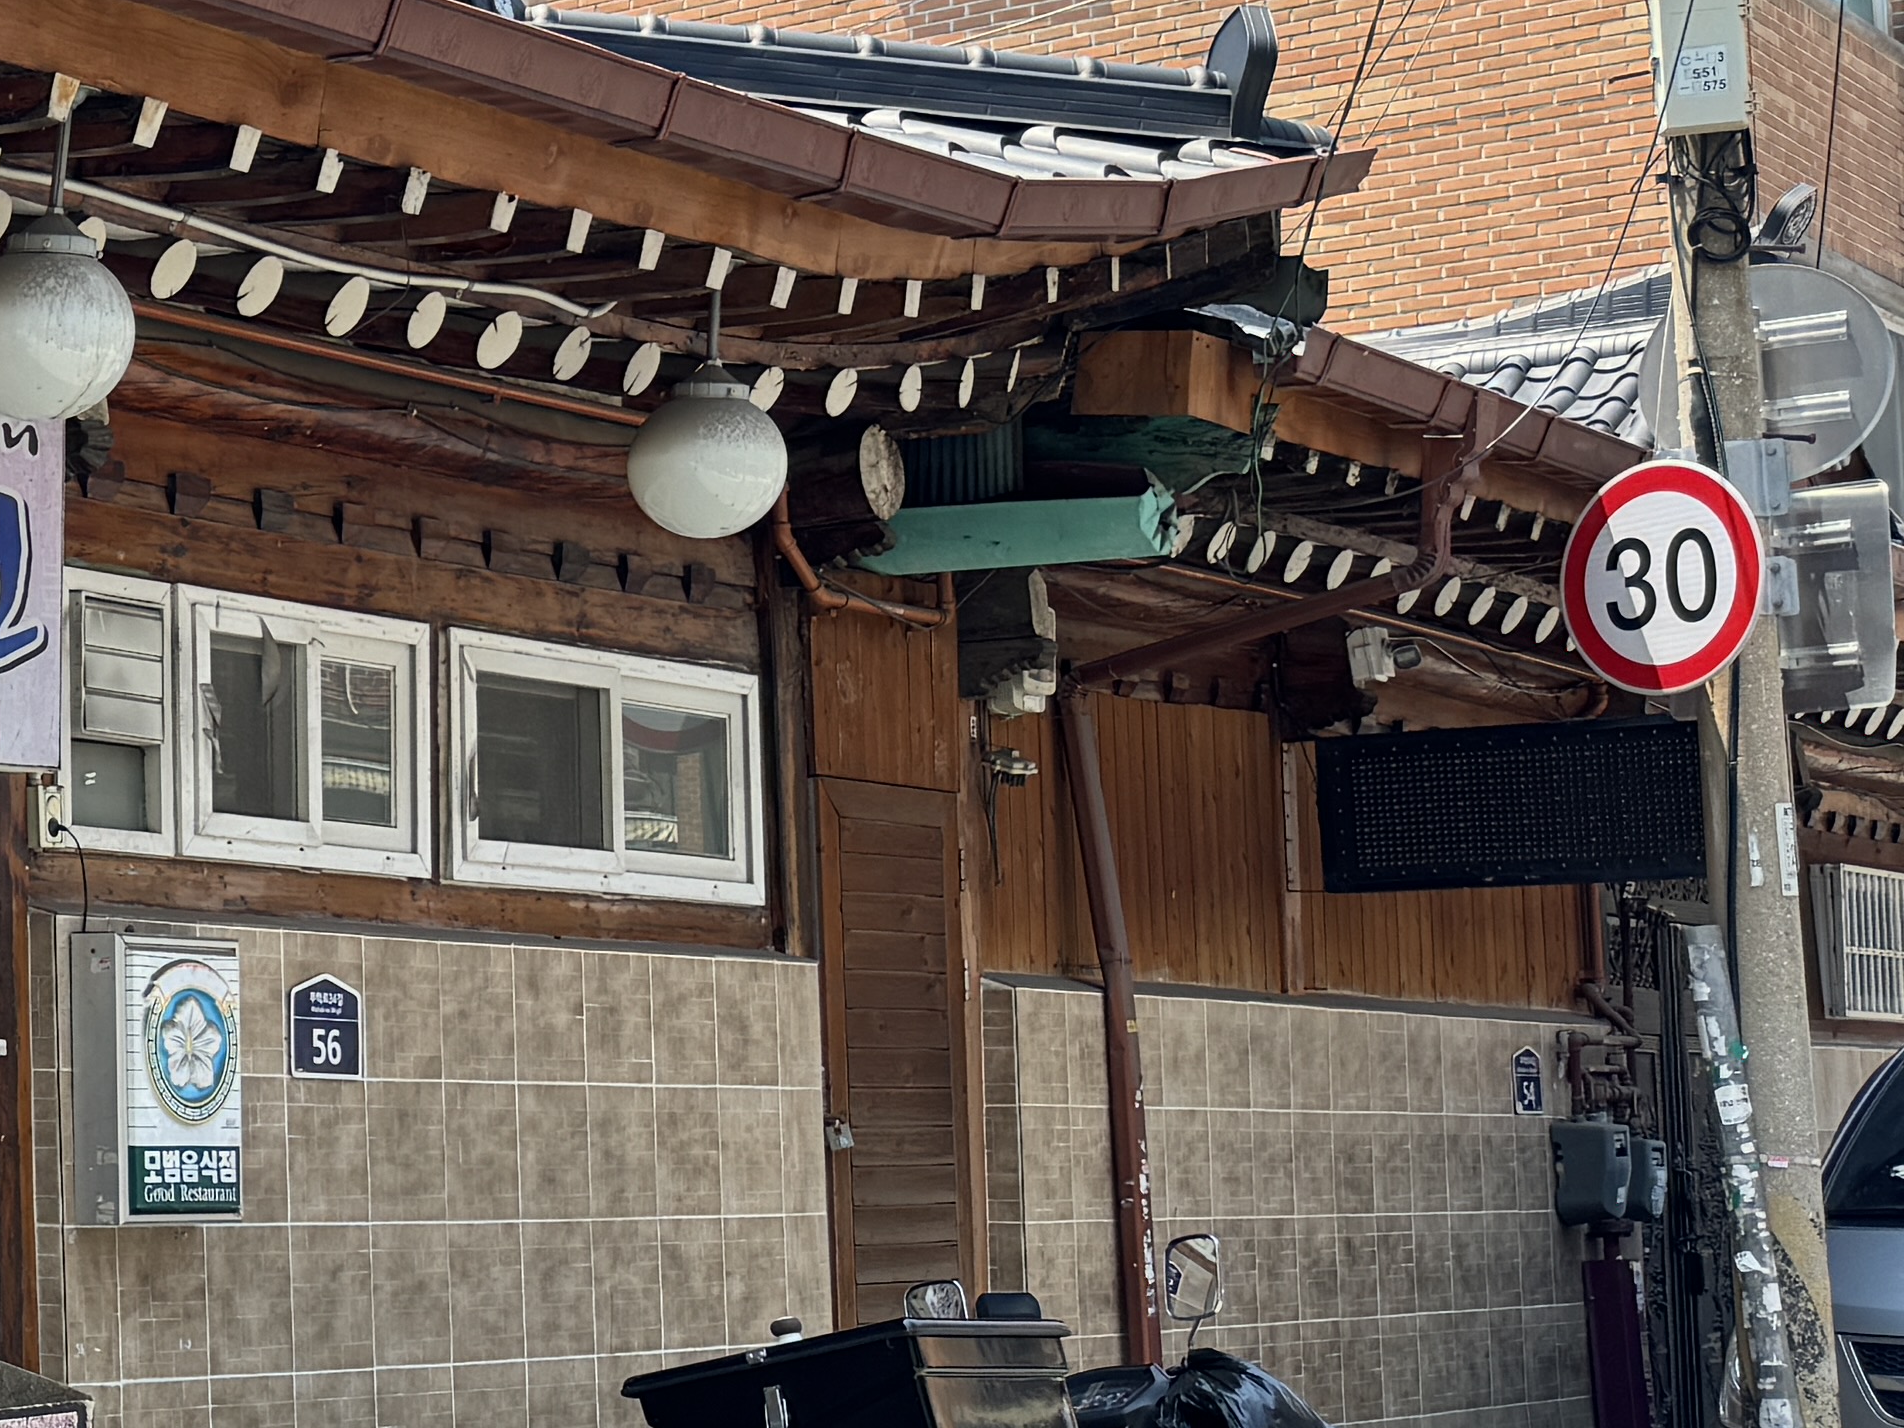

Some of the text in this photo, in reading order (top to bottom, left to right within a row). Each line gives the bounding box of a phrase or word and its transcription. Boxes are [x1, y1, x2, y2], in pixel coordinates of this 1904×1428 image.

[1605, 528, 1718, 631] 30
[312, 1028, 342, 1066] 56
[143, 1149, 237, 1185] 모범음식점
[144, 1184, 237, 1203] Good Restaurant
